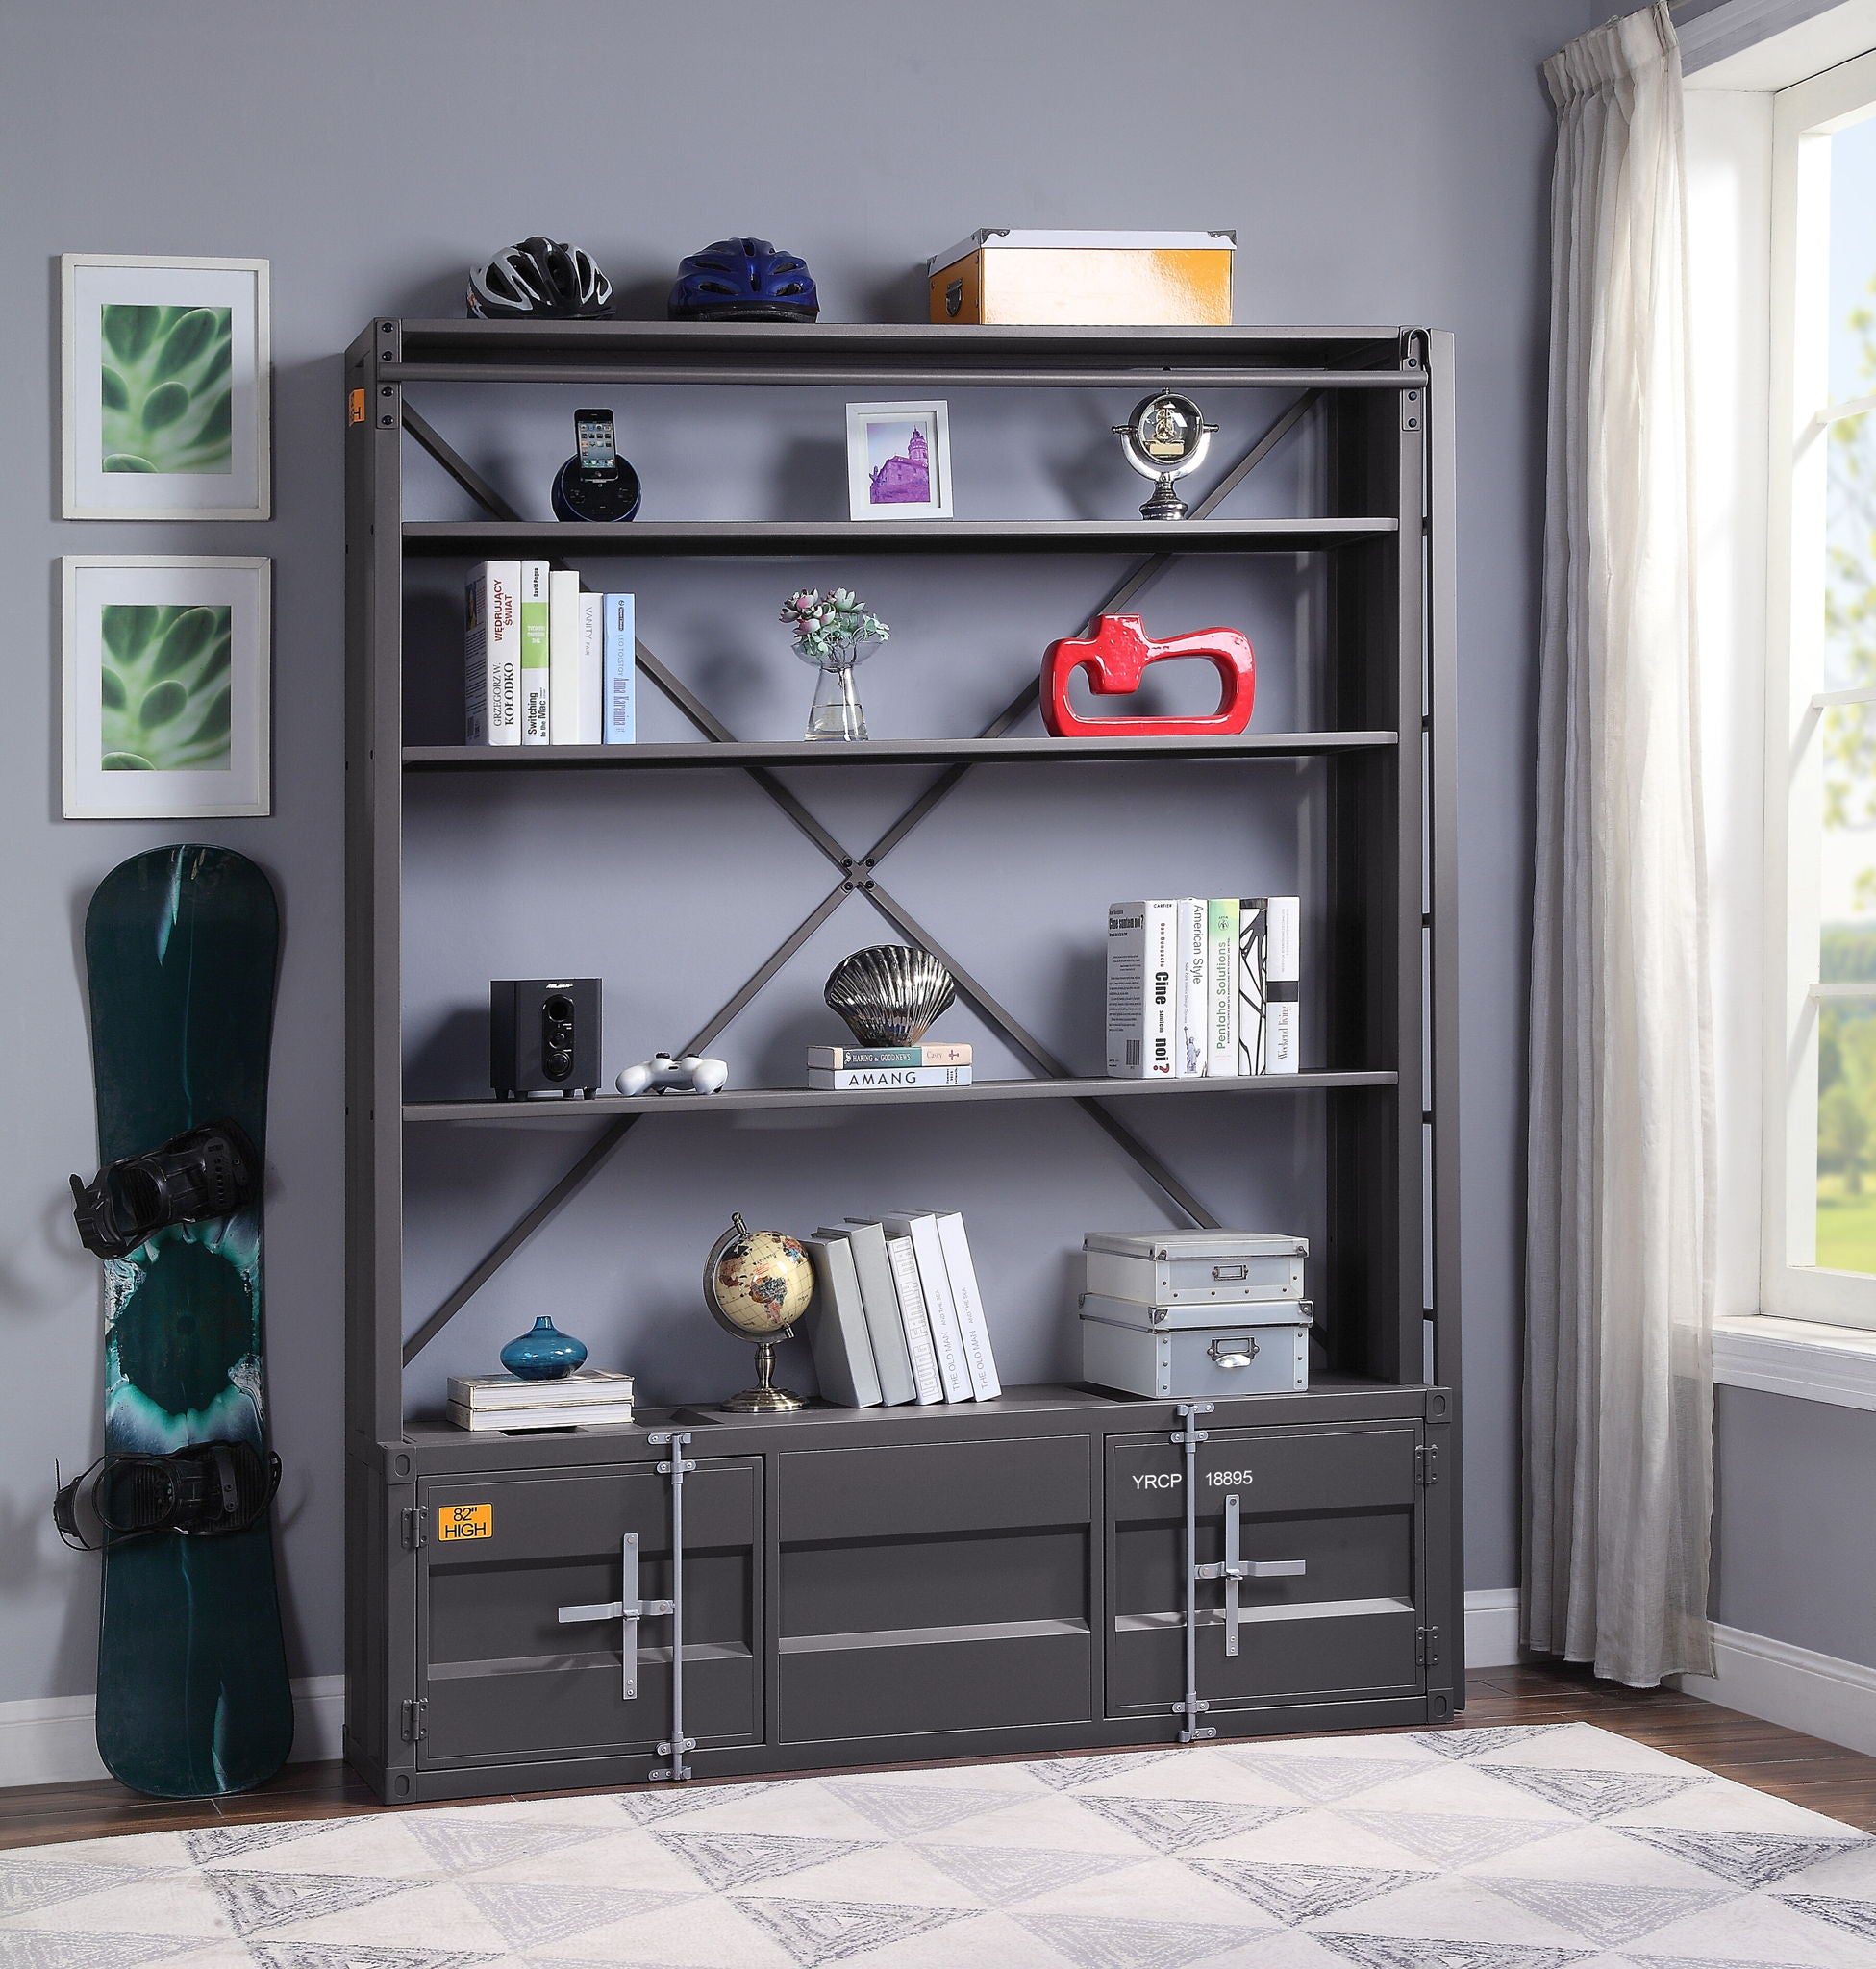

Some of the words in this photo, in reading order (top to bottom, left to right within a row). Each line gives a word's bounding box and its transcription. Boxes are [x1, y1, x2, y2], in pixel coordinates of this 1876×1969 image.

[494, 579, 504, 641] WĘDRUJĄCY
[504, 594, 513, 626] ŚWIAT
[585, 607, 593, 639] VANITY
[504, 662, 514, 726] KOŁODKO
[613, 678, 629, 694] Anna
[527, 692, 538, 735] Switching
[538, 700, 546, 719] Mac
[613, 696, 629, 726] Karenina
[1193, 904, 1204, 955] American
[1190, 958, 1204, 984] Style
[1216, 942, 1226, 995] Solutions
[1155, 971, 1169, 1005] Cine
[1216, 1001, 1226, 1049] Pentaho
[1279, 1006, 1291, 1026] living
[1278, 1028, 1288, 1060] Weekend
[848, 1071, 916, 1086] AMANG
[942, 1332, 953, 1352] MAN
[969, 1330, 980, 1350] MAN
[947, 1353, 957, 1372] OLD
[975, 1351, 985, 1370] OLD
[952, 1373, 961, 1391] THE
[980, 1371, 989, 1389] THE
[1132, 1473, 1183, 1489] YRCP
[1205, 1470, 1254, 1486] 18895
[453, 1507, 478, 1522] 82"
[445, 1522, 487, 1538] HIGH
